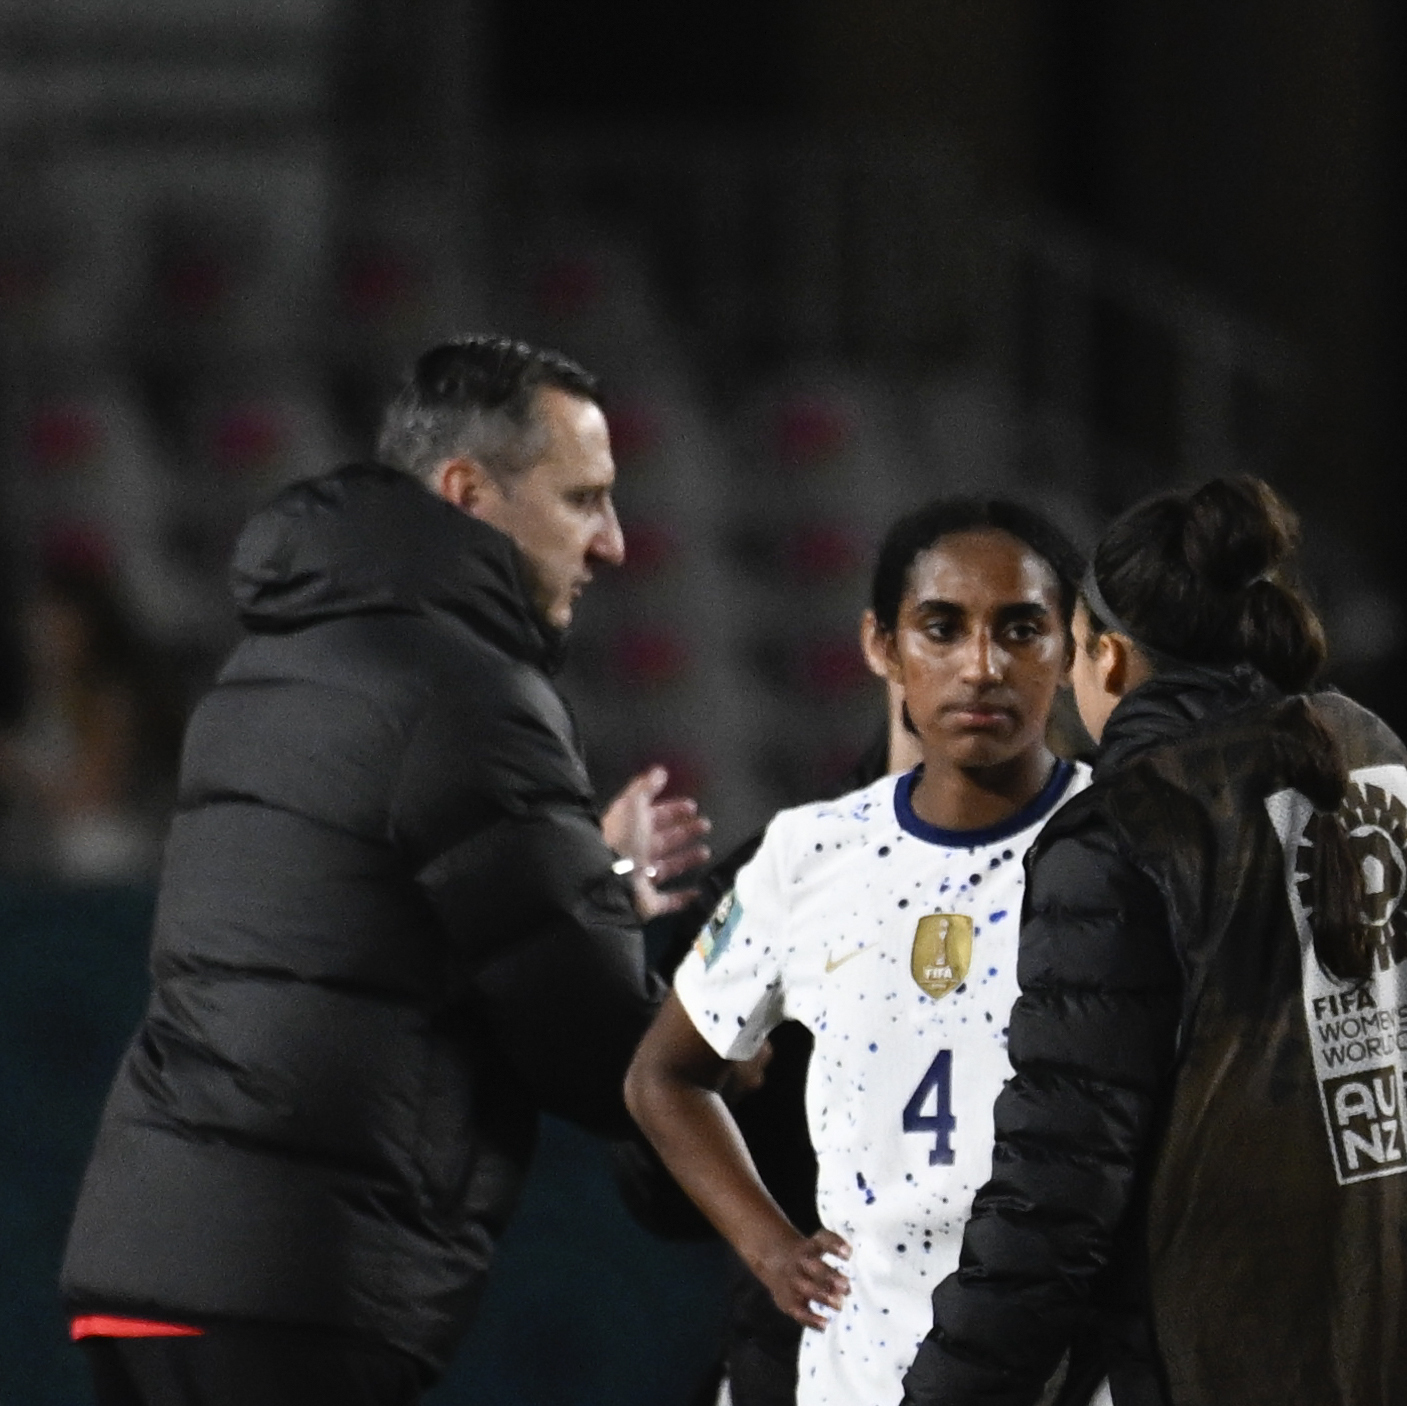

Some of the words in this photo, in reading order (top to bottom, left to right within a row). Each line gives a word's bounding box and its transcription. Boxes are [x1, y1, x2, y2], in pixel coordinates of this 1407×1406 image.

[922, 965, 953, 980] FIFA
[1312, 987, 1378, 1021] FIFA
[903, 1049, 956, 1167] 4
[1335, 1074, 1395, 1126] AU
[1342, 1119, 1402, 1170] NZ
